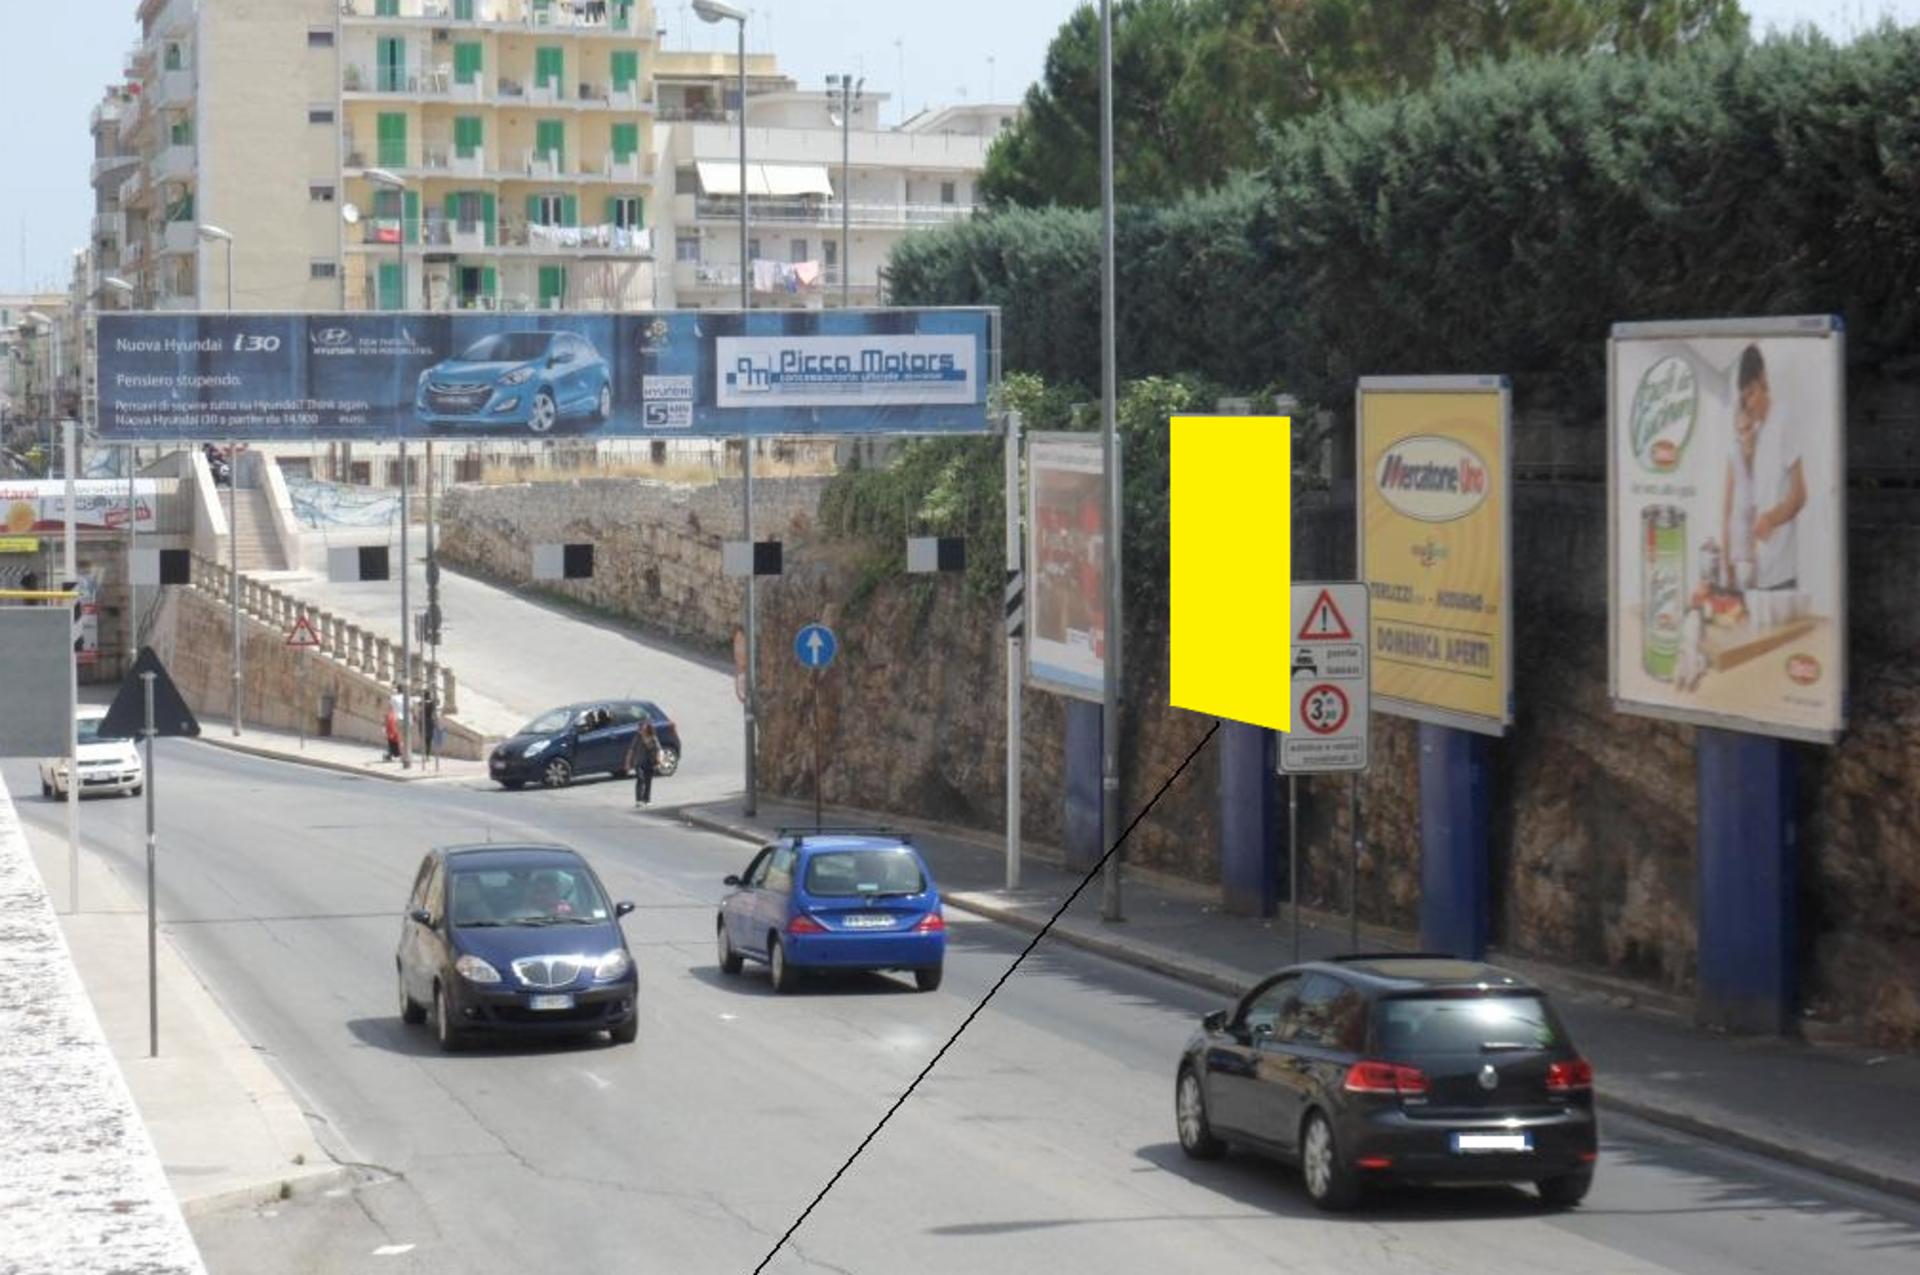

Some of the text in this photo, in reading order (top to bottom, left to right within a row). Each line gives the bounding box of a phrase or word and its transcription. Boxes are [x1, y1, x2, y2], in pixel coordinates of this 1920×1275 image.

[116, 332, 281, 354] Nuova Hyundai i30
[861, 349, 955, 374] Motors
[116, 373, 173, 387] Pensiero
[1377, 626, 1490, 669] DOMENICA APERTI
